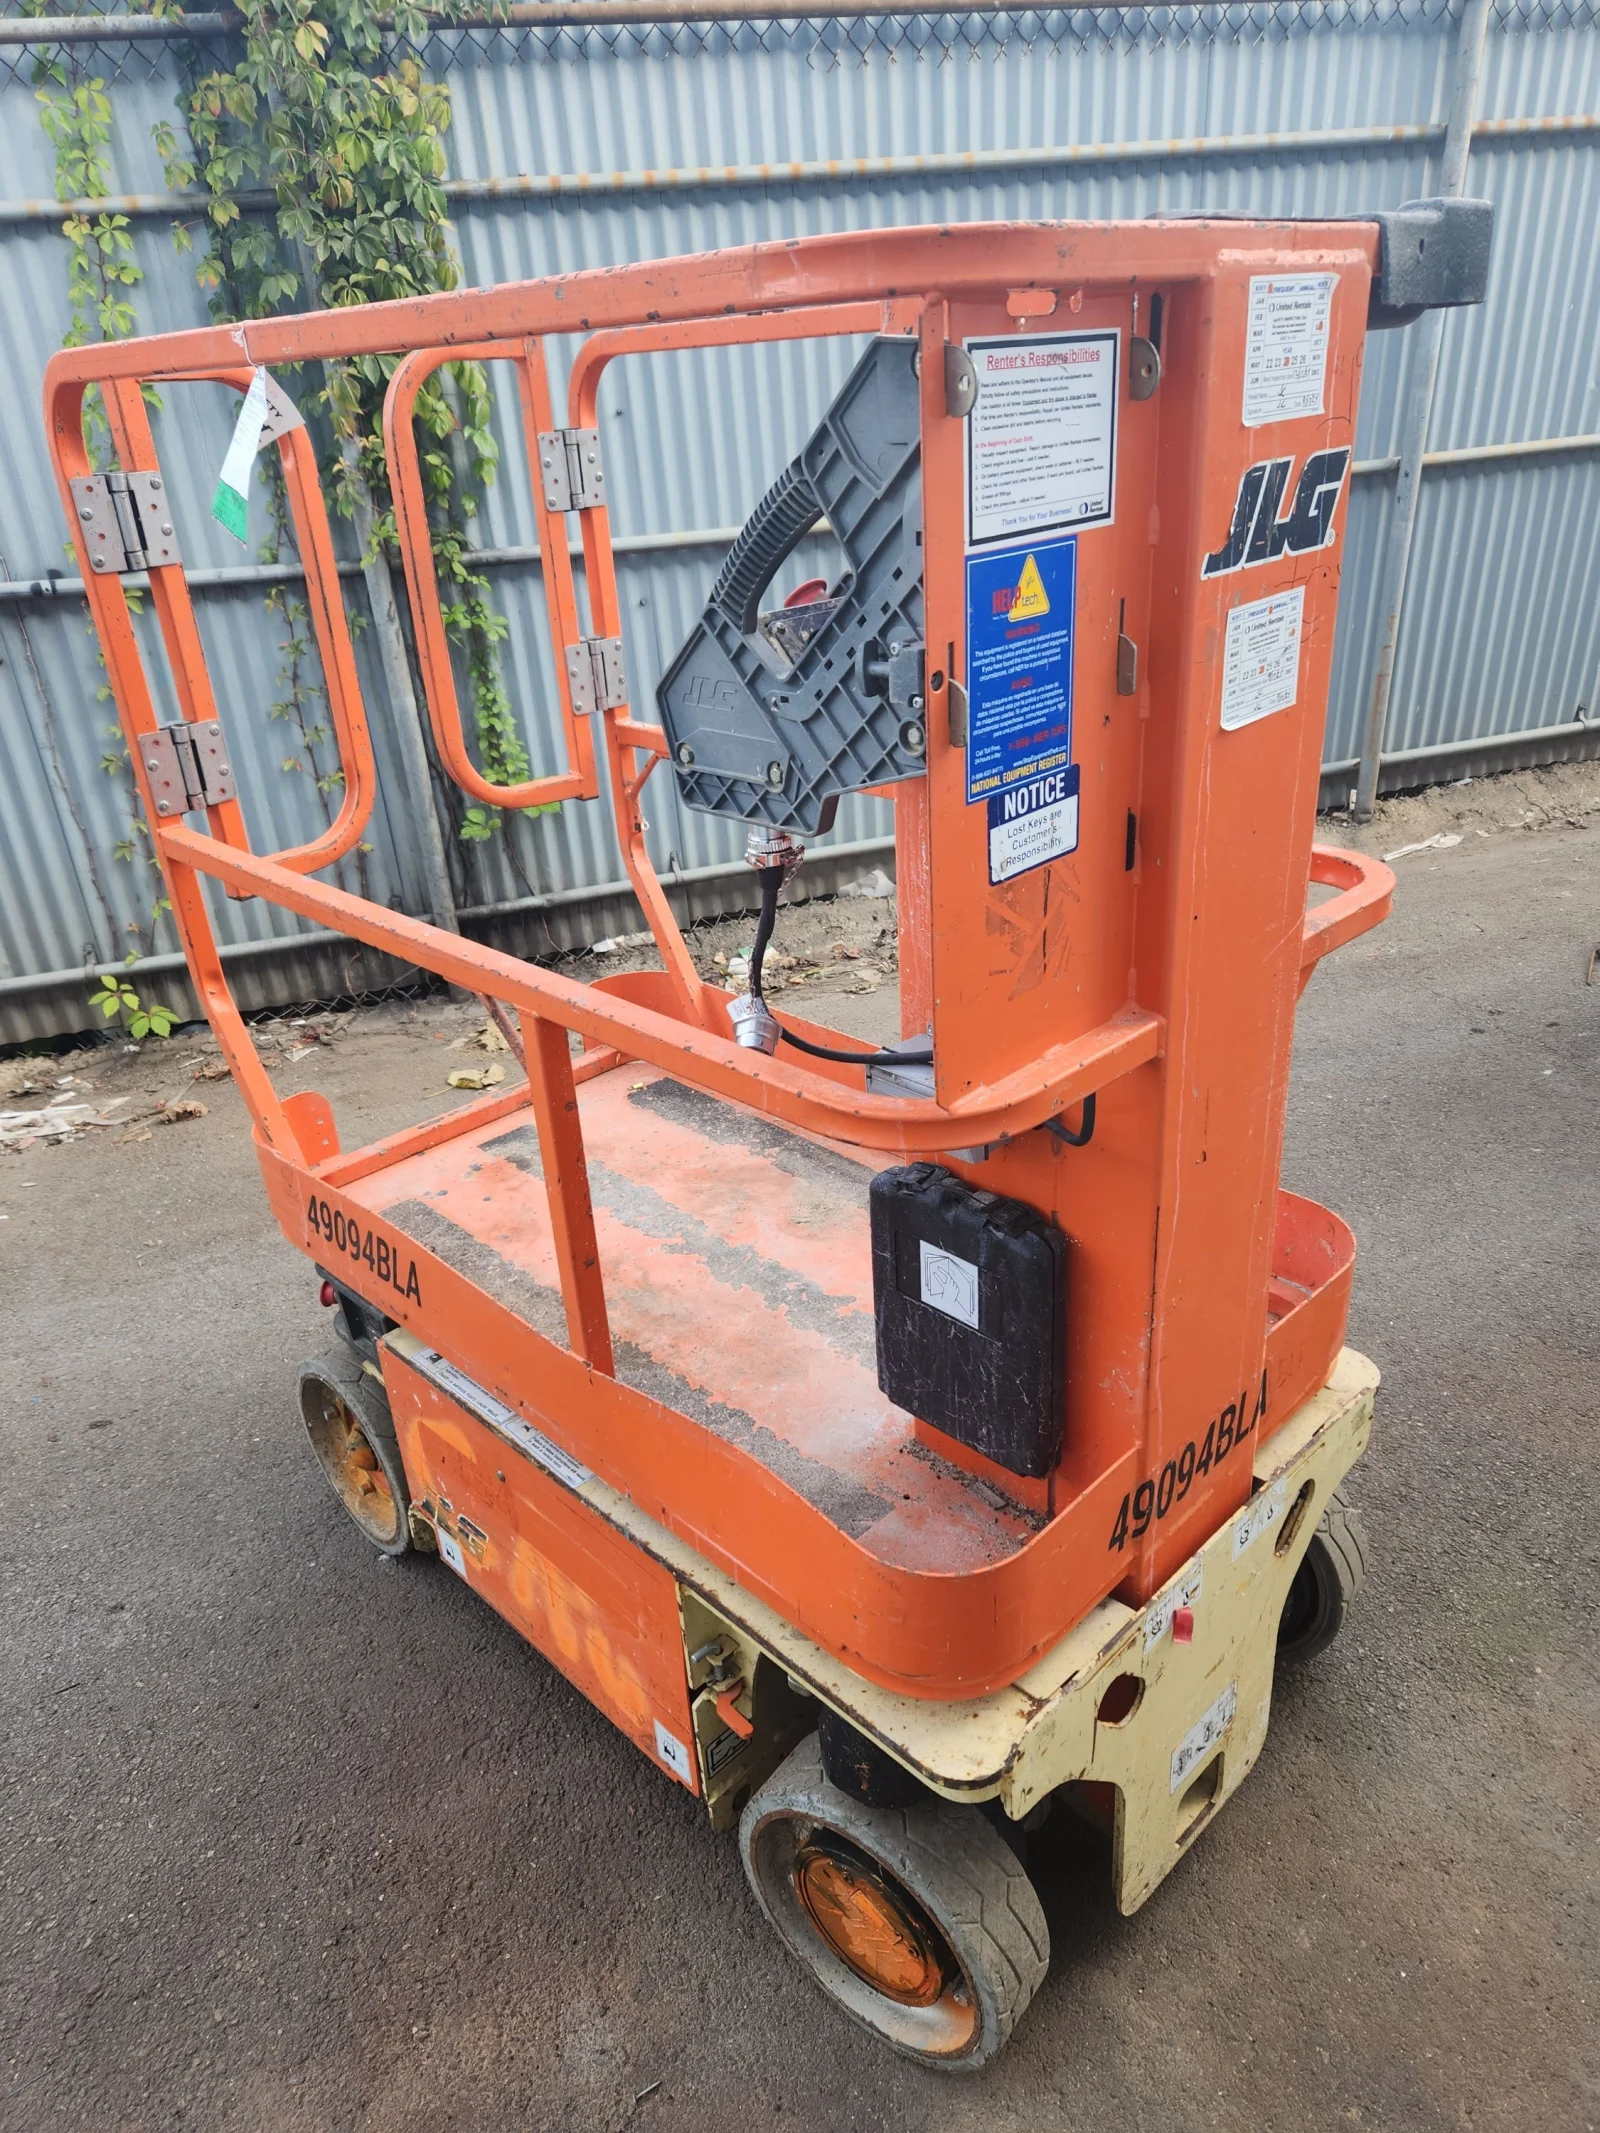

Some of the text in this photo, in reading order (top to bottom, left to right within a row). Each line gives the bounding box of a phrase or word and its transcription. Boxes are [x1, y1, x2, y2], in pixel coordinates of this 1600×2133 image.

[1276, 300, 1311, 311] United Rentals
[987, 347, 1100, 369] Renter's Responsibilities
[1002, 516, 1016, 527] Thank
[1018, 514, 1027, 524] You
[1037, 510, 1047, 520] Your
[1049, 505, 1072, 517] Business!
[1089, 498, 1103, 507] United
[1202, 447, 1350, 578] JLG
[983, 645, 1004, 656] equipment
[1051, 629, 1067, 639] database
[683, 676, 737, 711] JLG
[975, 749, 983, 757] Call
[980, 754, 990, 763] hours
[971, 752, 1066, 794] NATIONAL EQUIPMENT REGISTER
[1005, 772, 1065, 820] NOTICE
[1007, 810, 1062, 838] Lost Keys are
[1012, 825, 1057, 850] Customer's
[1005, 836, 1063, 867] Responsibility.
[308, 1195, 422, 1308] 49094BLA
[1108, 1368, 1267, 1553] 49094BLA
